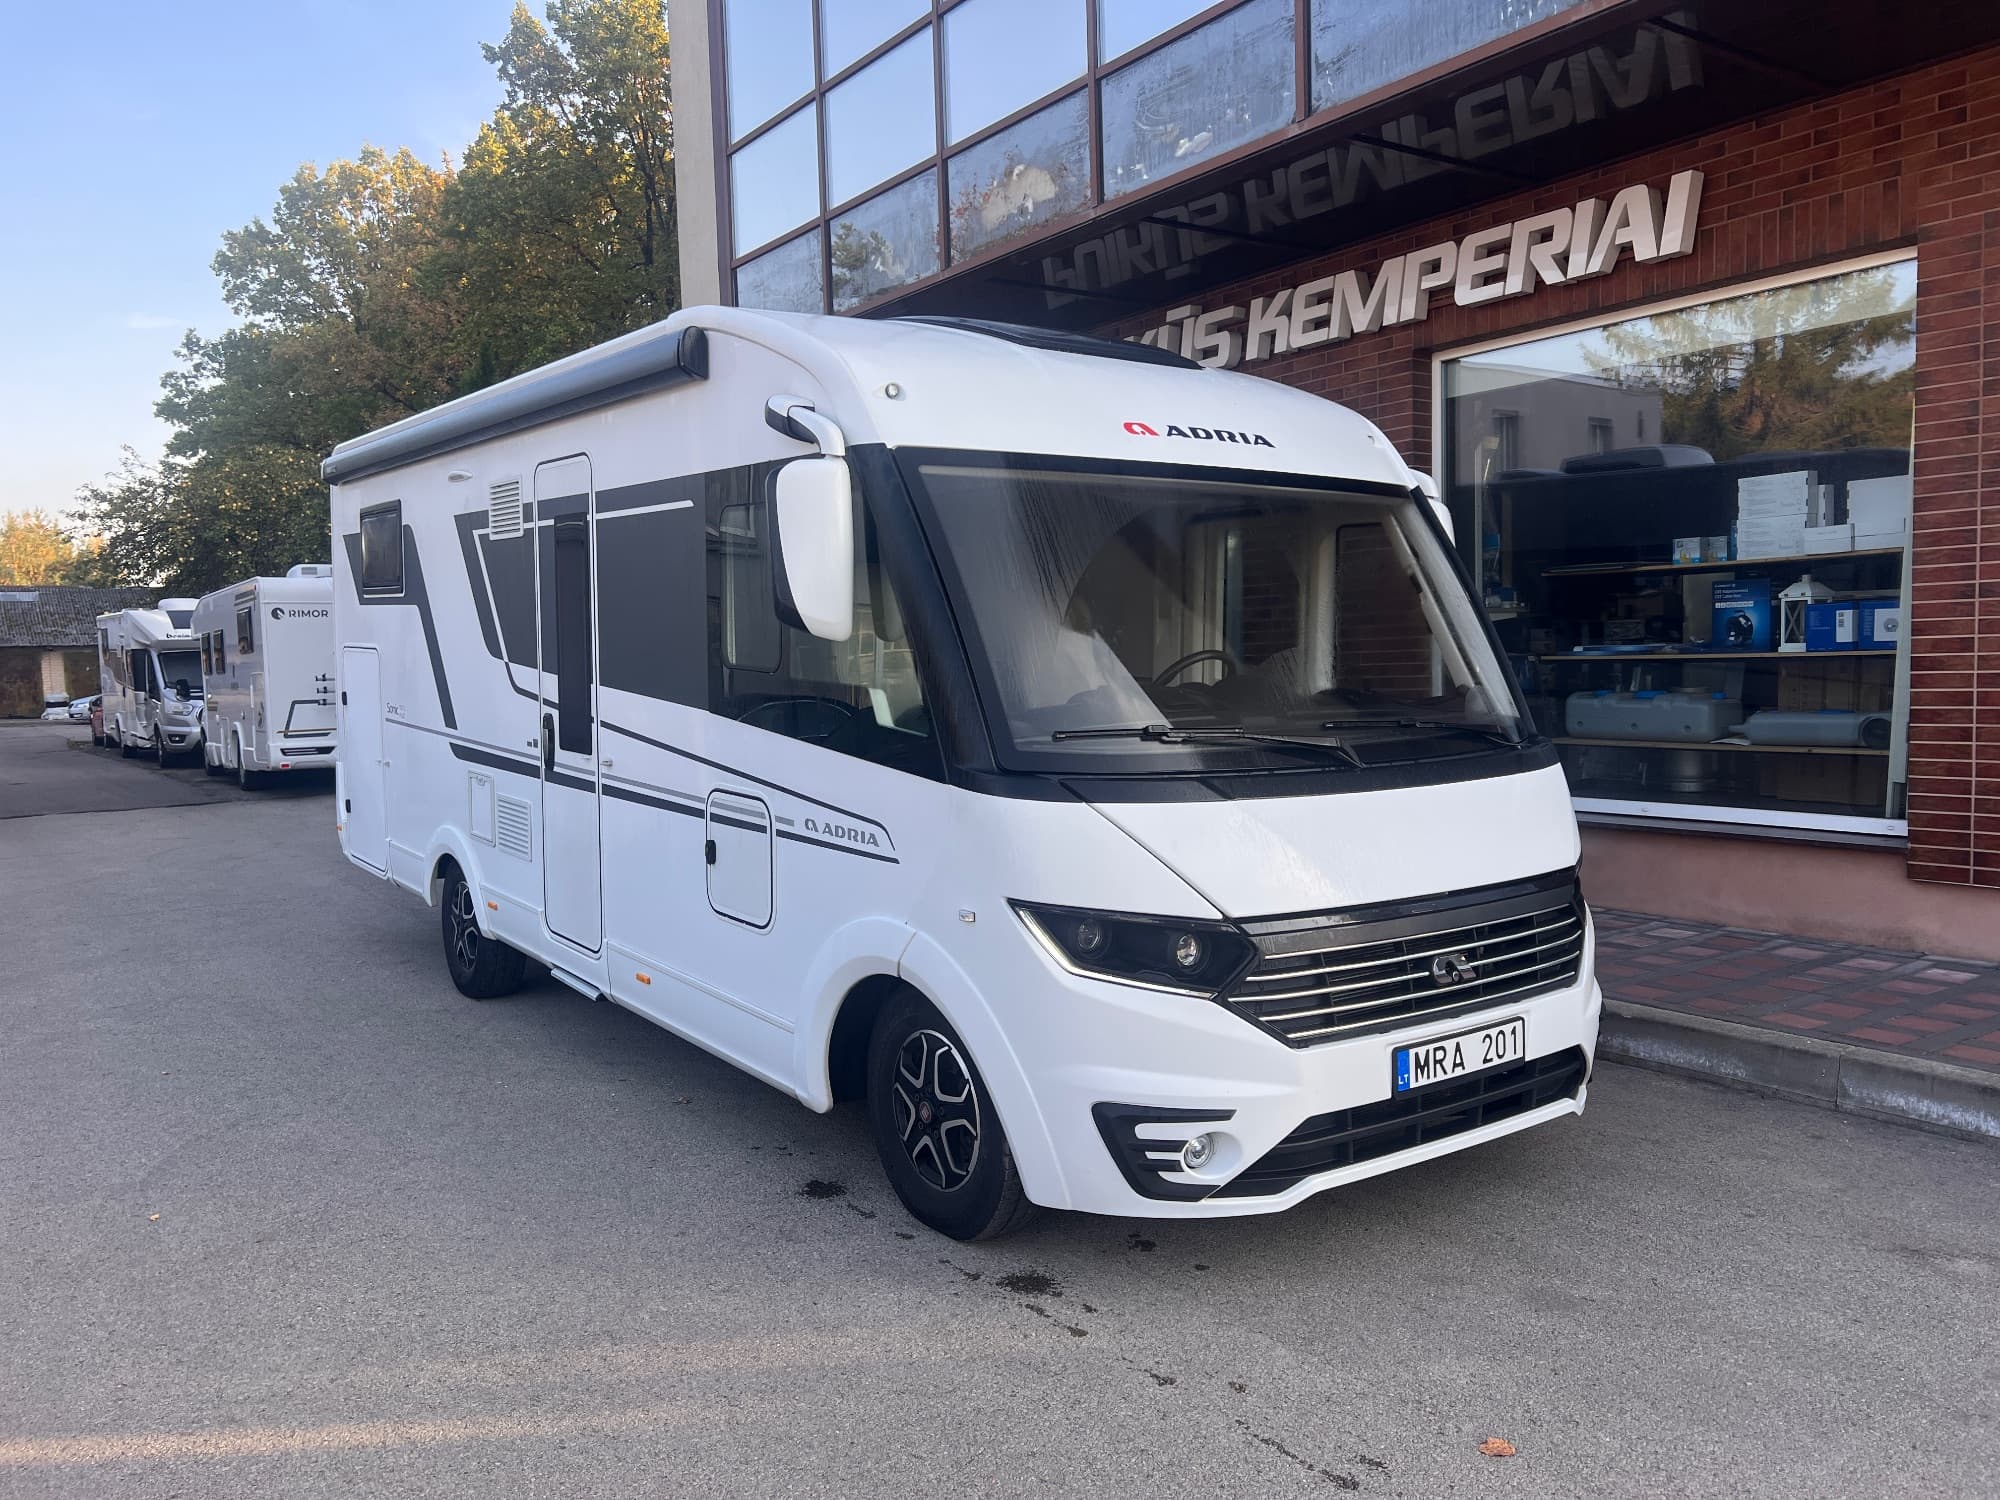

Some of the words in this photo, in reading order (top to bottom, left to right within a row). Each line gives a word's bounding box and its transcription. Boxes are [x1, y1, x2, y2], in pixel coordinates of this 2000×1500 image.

[1245, 169, 1705, 362] KEMPERIAI
[1165, 424, 1277, 449] ADRIA
[288, 609, 329, 618] RIMOR
[821, 822, 880, 848] ADRIA
[1414, 1041, 1466, 1083] MRA
[1482, 1025, 1517, 1064] 201
[1398, 1073, 1409, 1085] LT
